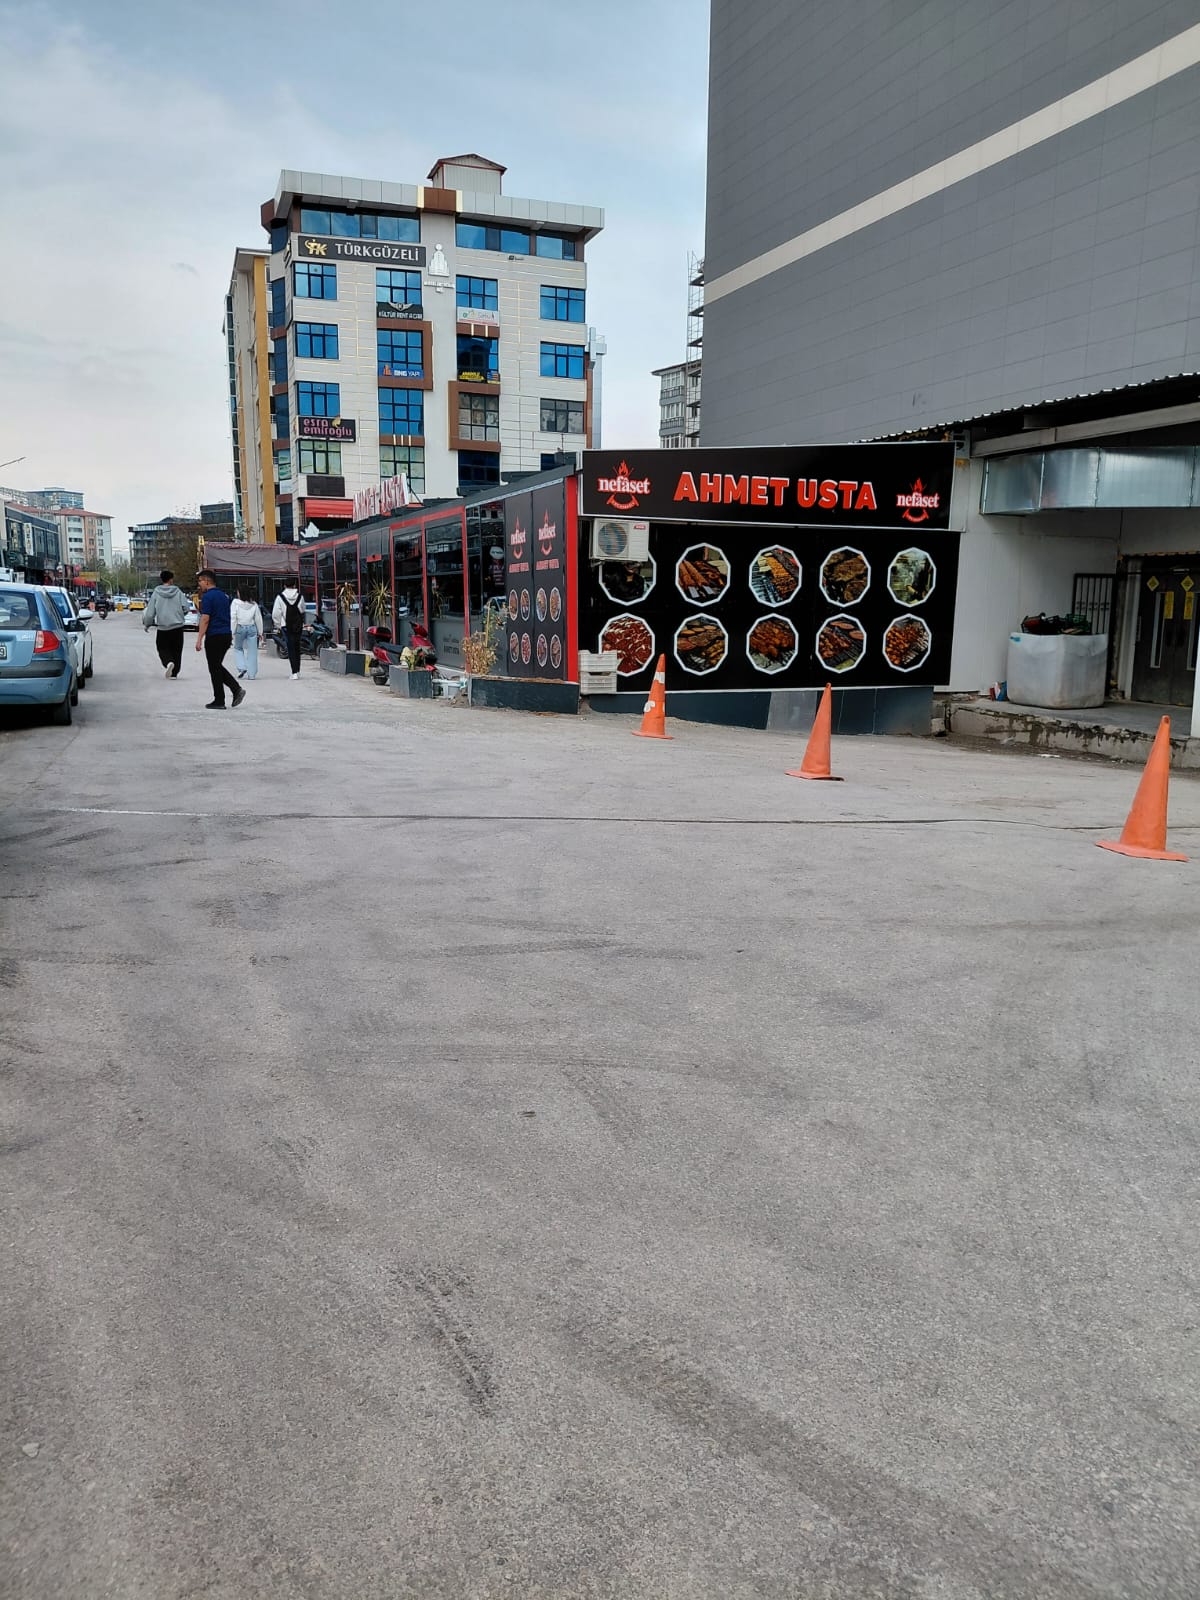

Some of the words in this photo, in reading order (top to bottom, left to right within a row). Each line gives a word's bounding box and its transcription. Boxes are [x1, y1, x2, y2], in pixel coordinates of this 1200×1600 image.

[335, 242, 419, 261] TÜRKGÜZELİ
[303, 418, 329, 427] esra
[673, 471, 790, 507] AHMET
[796, 478, 878, 510] USTA
